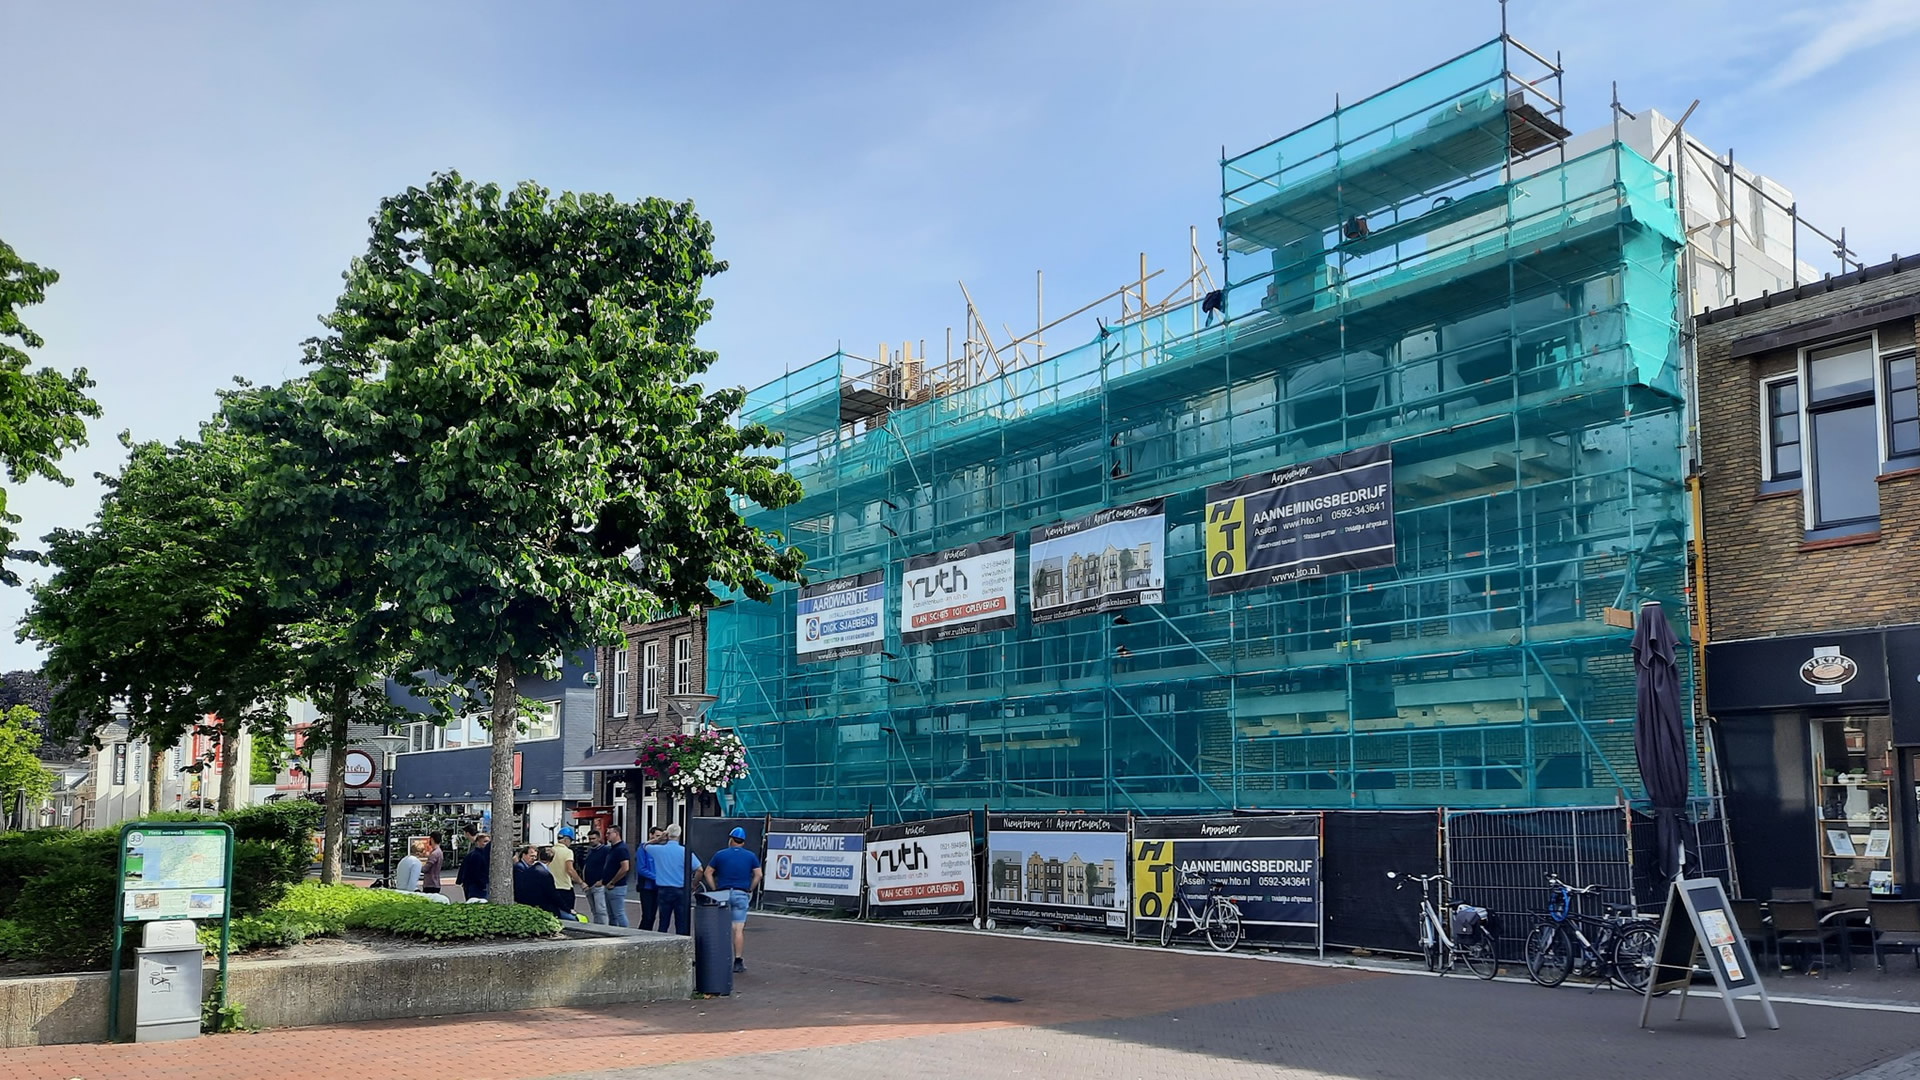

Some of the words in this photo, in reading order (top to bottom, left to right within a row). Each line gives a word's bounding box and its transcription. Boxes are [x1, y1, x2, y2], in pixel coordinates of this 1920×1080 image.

[1252, 484, 1387, 525] AANNEMINGSBEDRIJF
[1254, 525, 1277, 537] Assen
[1283, 514, 1323, 531] www.hto.nl
[1331, 501, 1386, 521] 0592-343641
[1272, 565, 1321, 582] www.hto.nl
[907, 565, 968, 600] ruth
[812, 588, 869, 612] AARDWARMTE
[915, 614, 928, 624] VAN
[965, 599, 1000, 613] OPLEVERING
[823, 621, 838, 634] DICK
[839, 615, 876, 631] SJABBENS
[1804, 656, 1851, 671] TIKTAK
[1003, 816, 1042, 829] Nieuwbouw
[1046, 818, 1052, 828] 11
[1056, 818, 1110, 831] Appartementen
[131, 834, 142, 843] 33
[785, 836, 845, 851] AARDWARMTE
[871, 842, 928, 873] ruth
[794, 865, 811, 876] DICK
[812, 866, 850, 877] SJABBENS
[1181, 860, 1313, 873] AANNEMINGSBEDRIJF
[1183, 877, 1205, 886] Assen
[1258, 877, 1311, 887] 0592-343641
[881, 889, 894, 898] VAN
[915, 887, 925, 895] TOT
[927, 883, 959, 893] OPLEVERING
